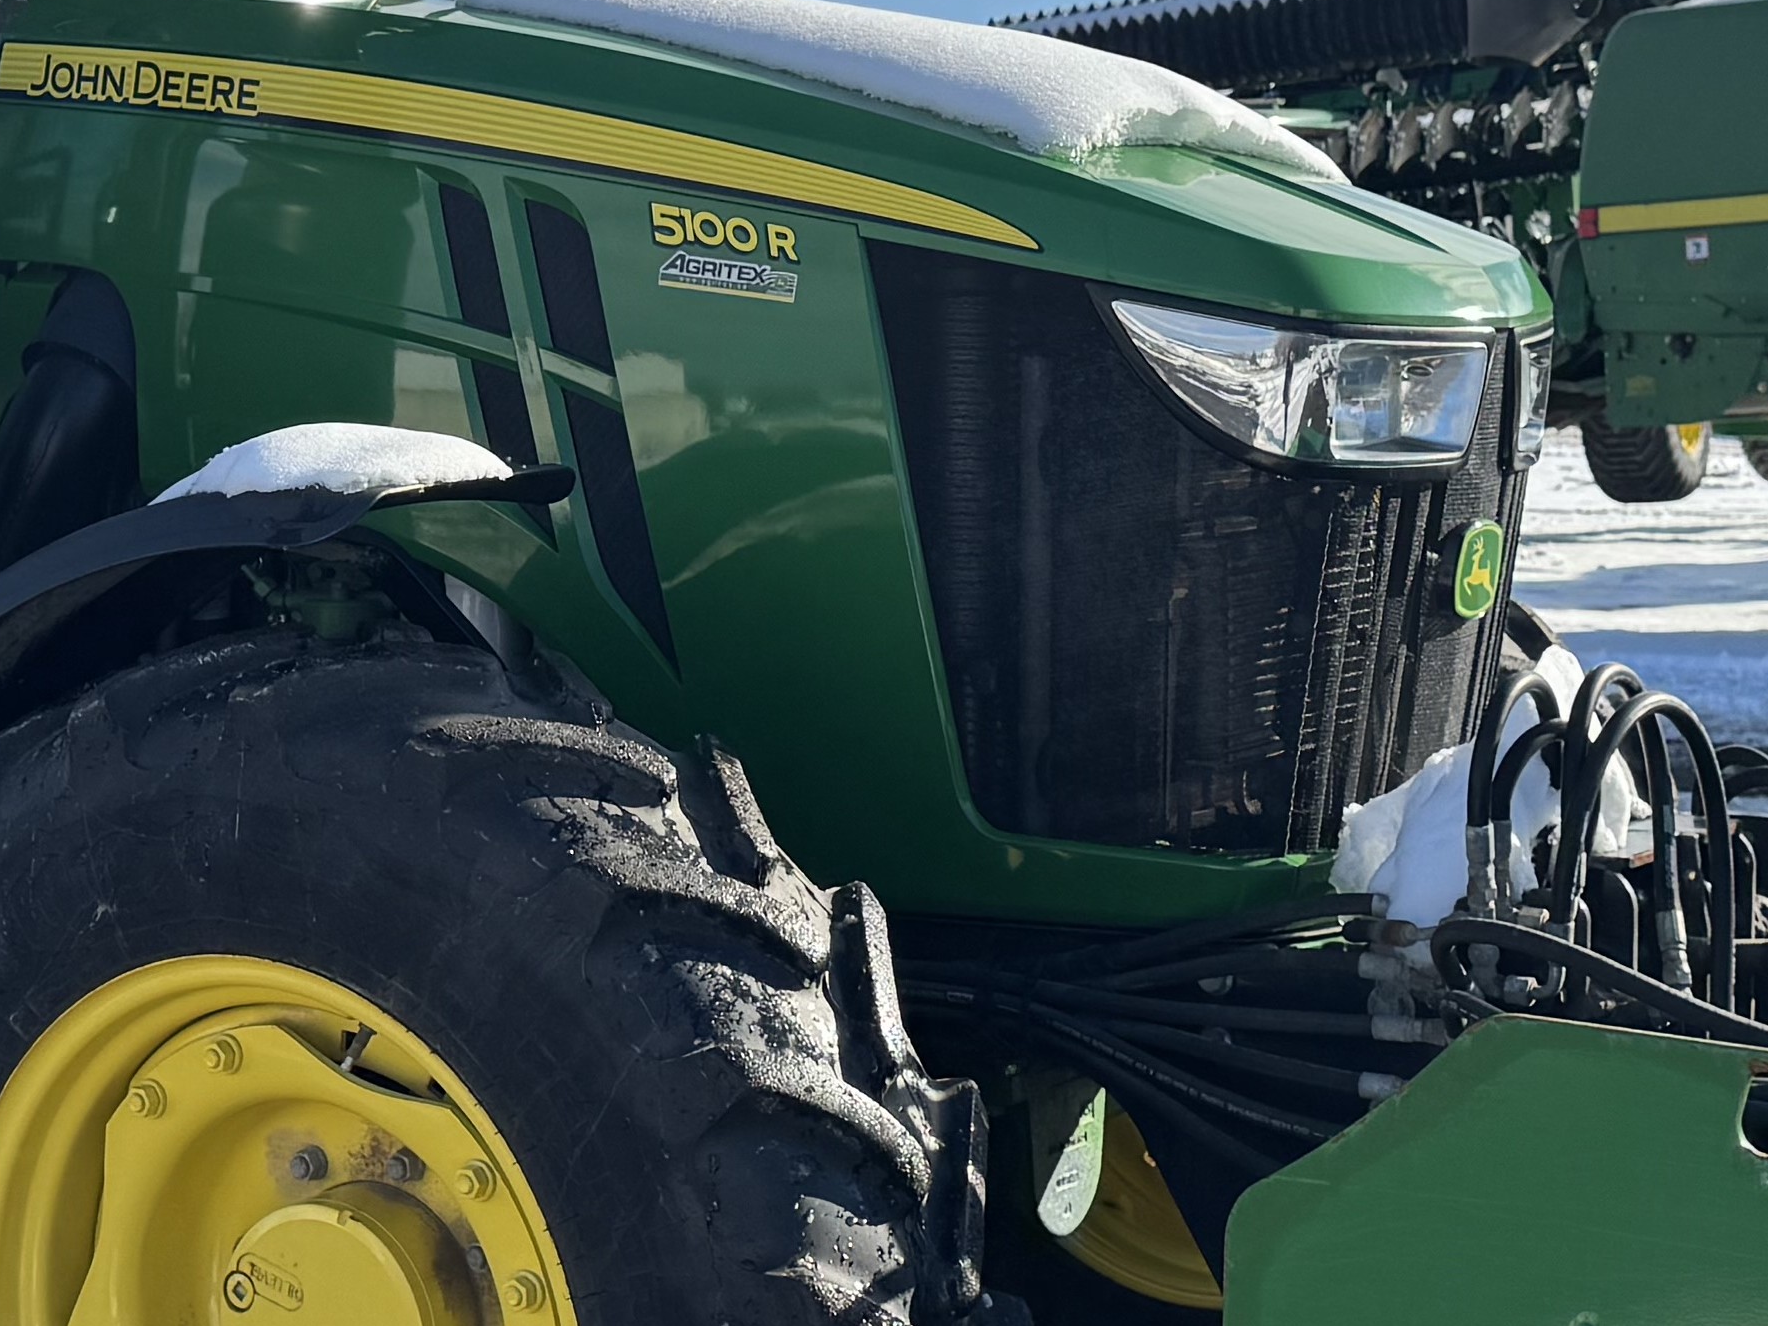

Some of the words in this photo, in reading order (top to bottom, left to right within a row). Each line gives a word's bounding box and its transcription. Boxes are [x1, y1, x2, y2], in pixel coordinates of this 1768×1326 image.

[29, 53, 127, 98] JOHN
[132, 60, 261, 112] DEERE
[650, 201, 759, 254] 5100
[766, 222, 800, 264] R
[661, 252, 769, 284] AGRITEX
